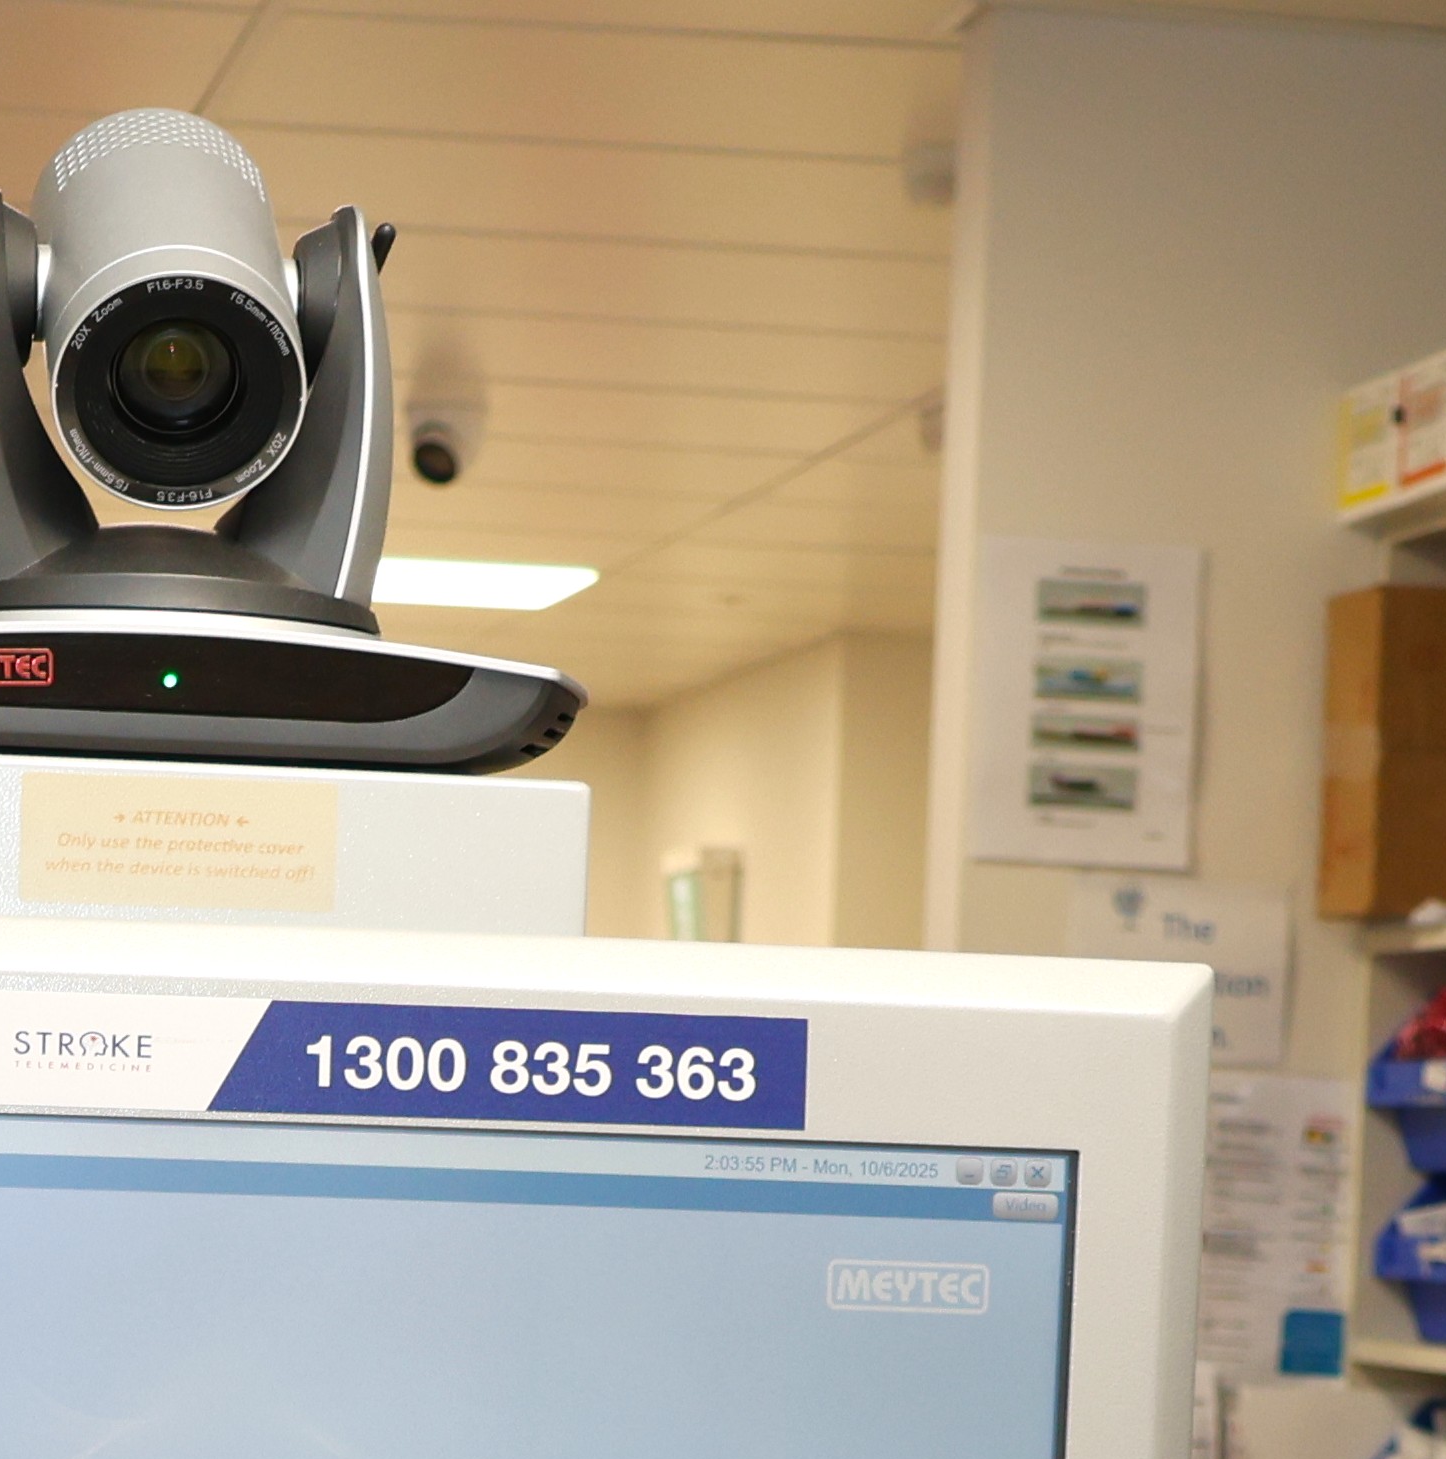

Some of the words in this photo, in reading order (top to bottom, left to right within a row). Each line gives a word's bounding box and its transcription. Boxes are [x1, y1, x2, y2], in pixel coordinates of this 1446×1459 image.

[70, 324, 92, 350] 20X
[91, 296, 124, 323] Zoom
[234, 458, 267, 484] Zoom
[131, 809, 231, 828] ATTENTION
[57, 831, 96, 850] Only
[100, 836, 130, 849] use
[136, 835, 163, 850] the
[167, 837, 253, 856] protective
[258, 843, 305, 855] cover
[44, 857, 92, 873] when
[97, 858, 124, 874] the
[129, 860, 184, 876] device
[187, 863, 201, 876] is
[207, 863, 280, 880] switched
[14, 1060, 153, 1073] TELEMEDICINE
[305, 1034, 468, 1092] 1300
[489, 1041, 611, 1098] 835
[635, 1045, 757, 1102] 363
[704, 1154, 765, 1172] 2:03:55
[770, 1157, 798, 1174] PM
[812, 1158, 853, 1178] Mon,
[860, 1160, 939, 1180] 10/6/2025
[1004, 1198, 1048, 1214] Video
[835, 1268, 983, 1305] MEYTEC
